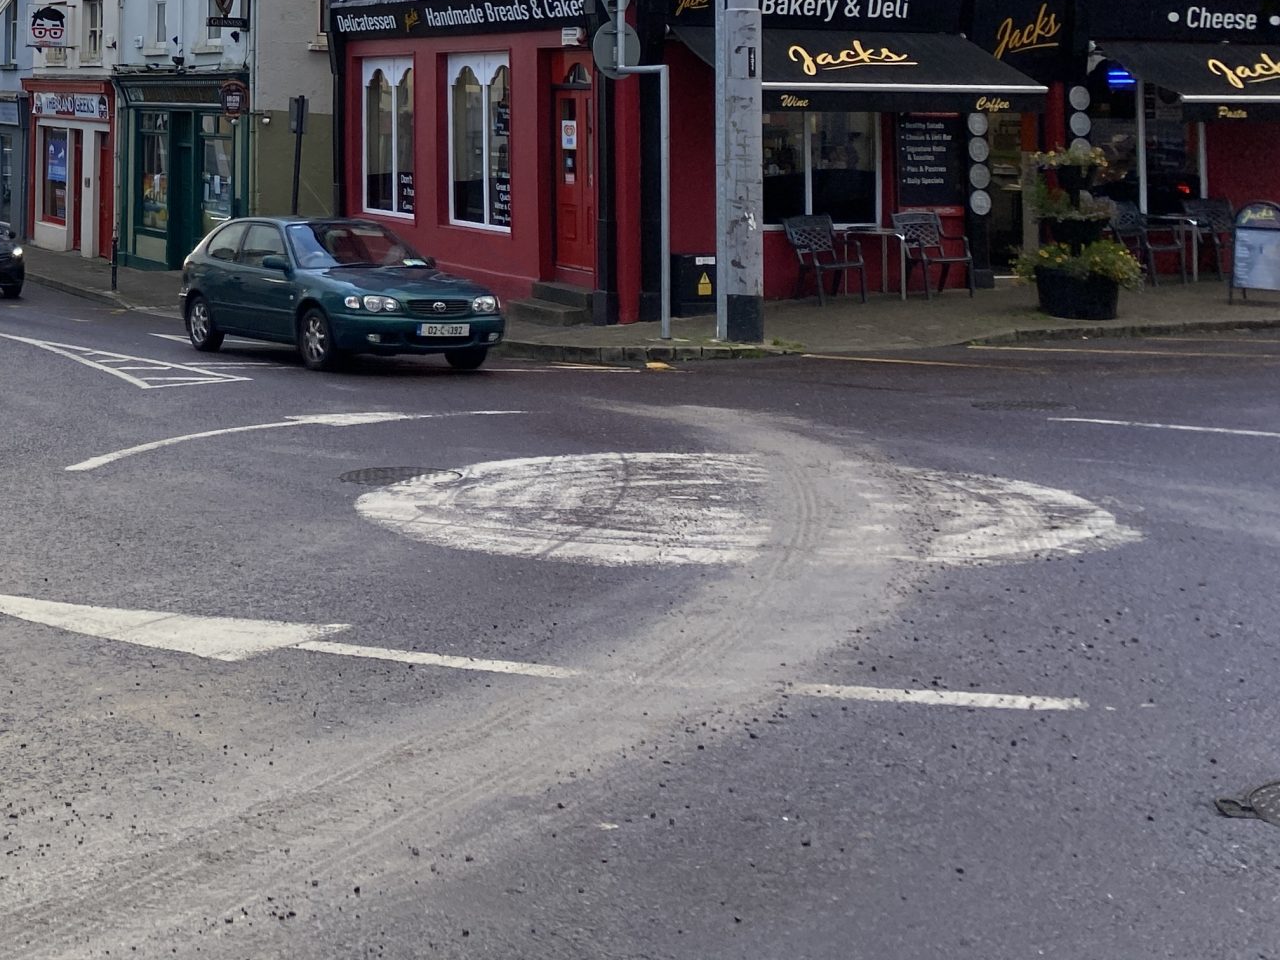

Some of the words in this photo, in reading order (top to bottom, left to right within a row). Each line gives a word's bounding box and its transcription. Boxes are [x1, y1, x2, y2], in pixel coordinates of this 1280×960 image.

[211, 18, 243, 26] GUINNESS
[336, 14, 397, 33] Delicatessen
[425, 4, 485, 27] Handmade
[485, 0, 529, 22] Breads
[1186, 6, 1258, 30] Cheese
[994, 2, 1061, 60] Jacks
[787, 39, 911, 76] Jacks
[75, 97, 95, 114] GEEKS
[780, 94, 810, 107] Wine
[976, 96, 1010, 112] Coffee
[1240, 208, 1275, 224] Jacks
